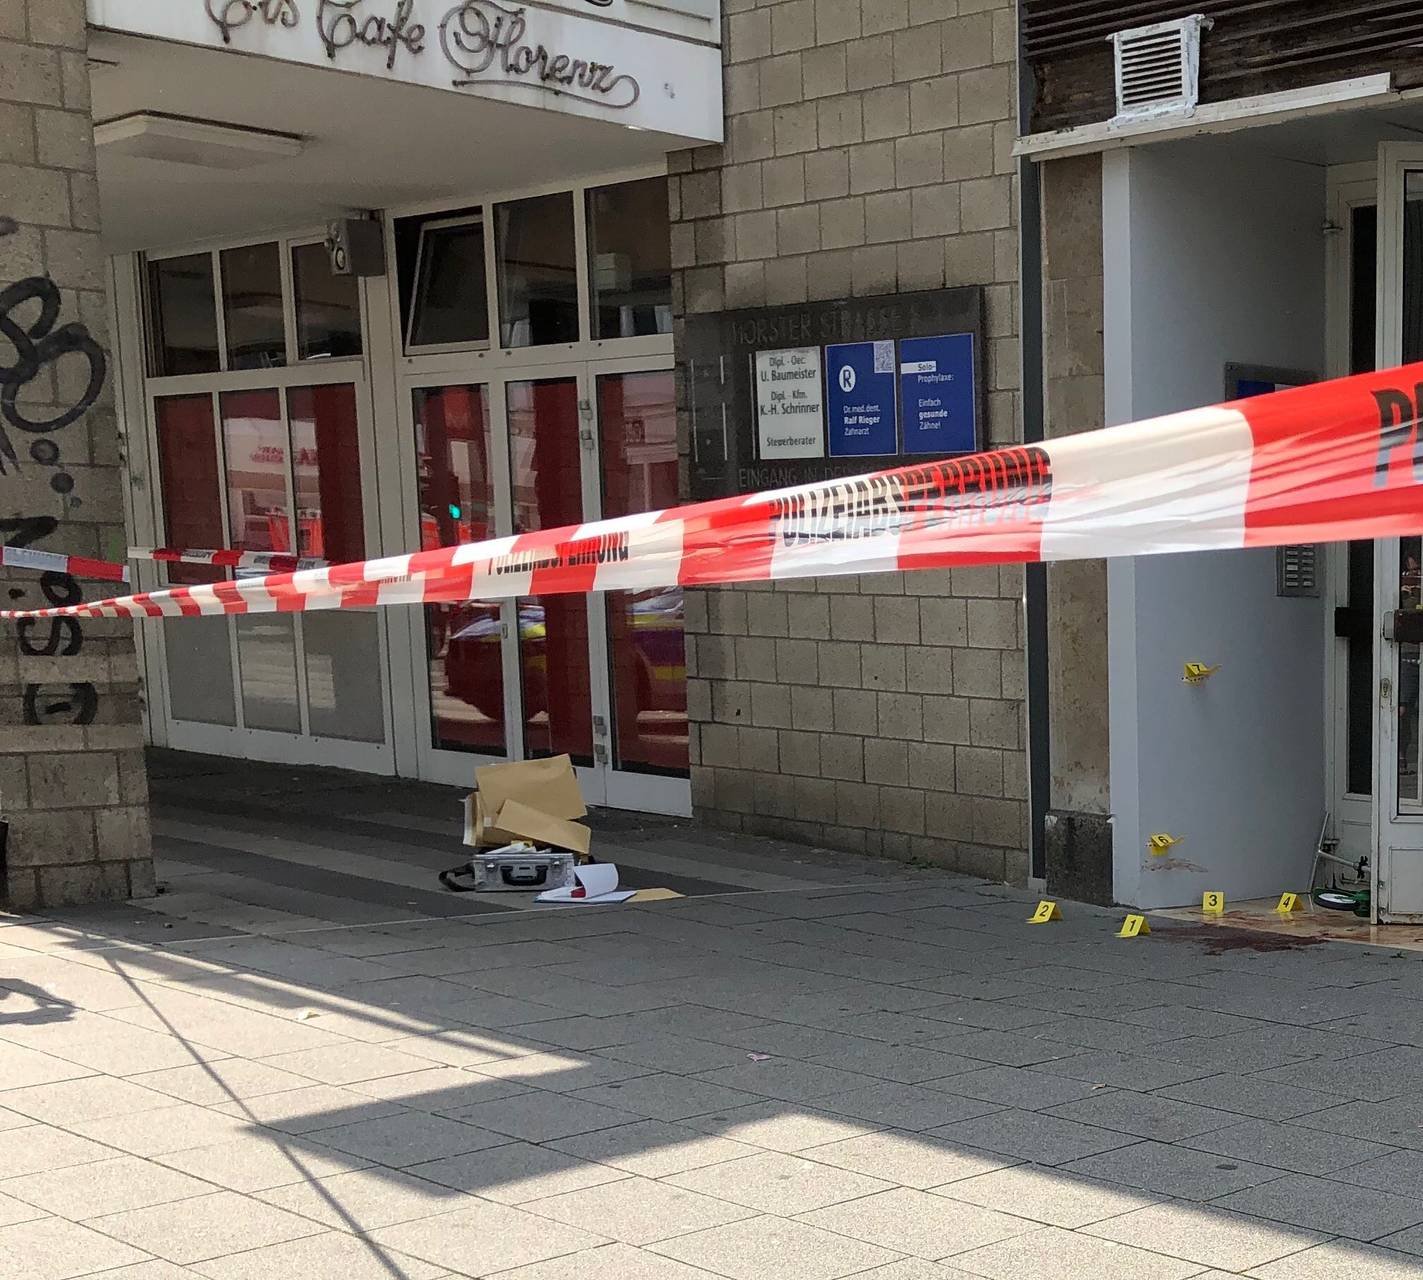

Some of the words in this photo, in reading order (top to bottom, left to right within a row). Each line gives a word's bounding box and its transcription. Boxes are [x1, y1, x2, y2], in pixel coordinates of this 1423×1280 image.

[761, 371, 769, 382] U.
[771, 367, 817, 382] Baumeister
[781, 402, 820, 415] Schrinner
[918, 398, 941, 408] Einfach
[844, 416, 857, 425] Ralf
[858, 415, 880, 426] Rieger
[919, 409, 948, 420] gesunde
[766, 436, 817, 447] Steuerberater
[1208, 894, 1218, 907] 3
[1283, 896, 1291, 908] 4
[1039, 904, 1049, 917] 2
[1130, 919, 1137, 932] 1
